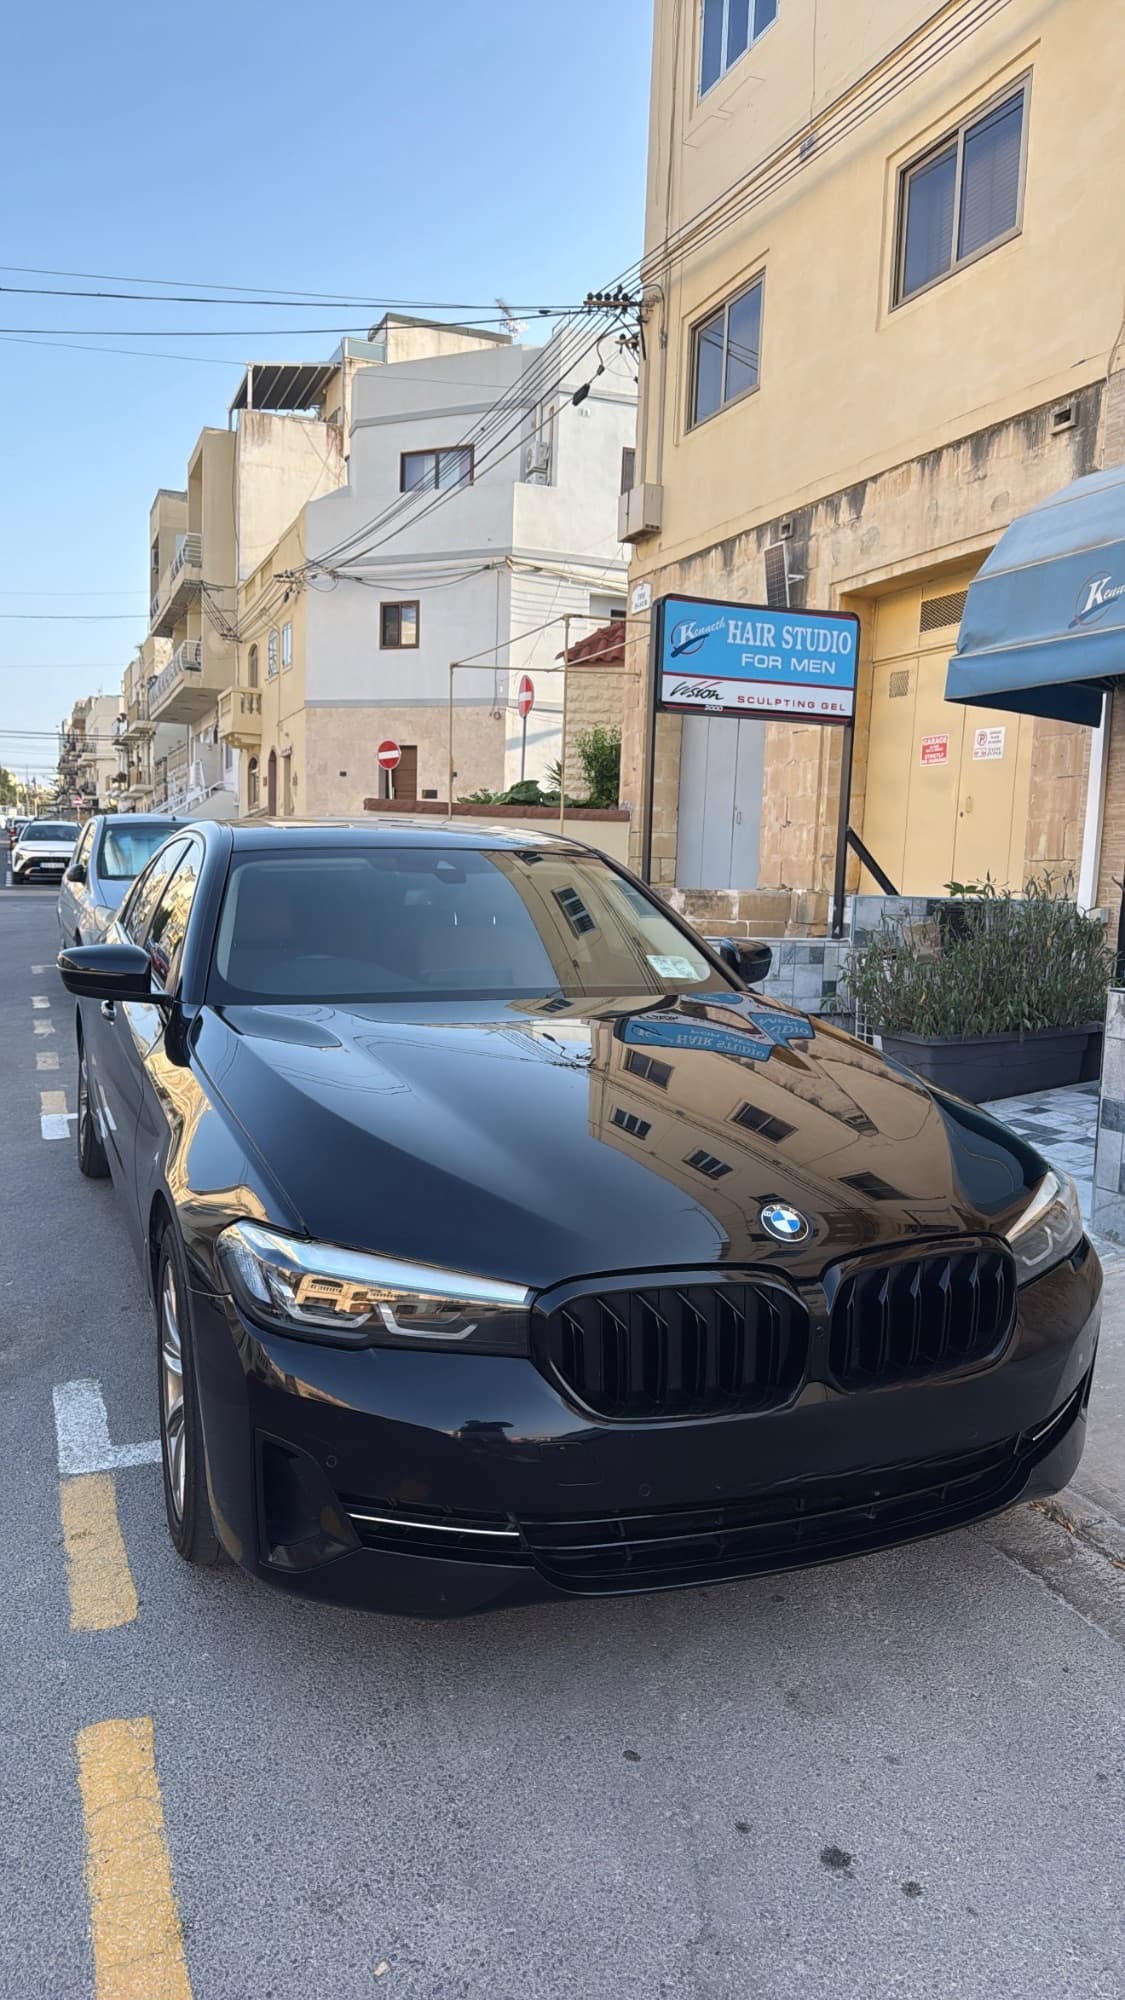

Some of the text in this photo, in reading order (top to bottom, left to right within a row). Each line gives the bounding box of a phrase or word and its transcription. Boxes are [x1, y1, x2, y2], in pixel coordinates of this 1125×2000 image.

[678, 616, 852, 655] Kenneth HAIR STUDIO
[741, 652, 837, 674] FOR MEN
[669, 680, 725, 700] Vision
[737, 695, 846, 711] SCULPTING GEL
